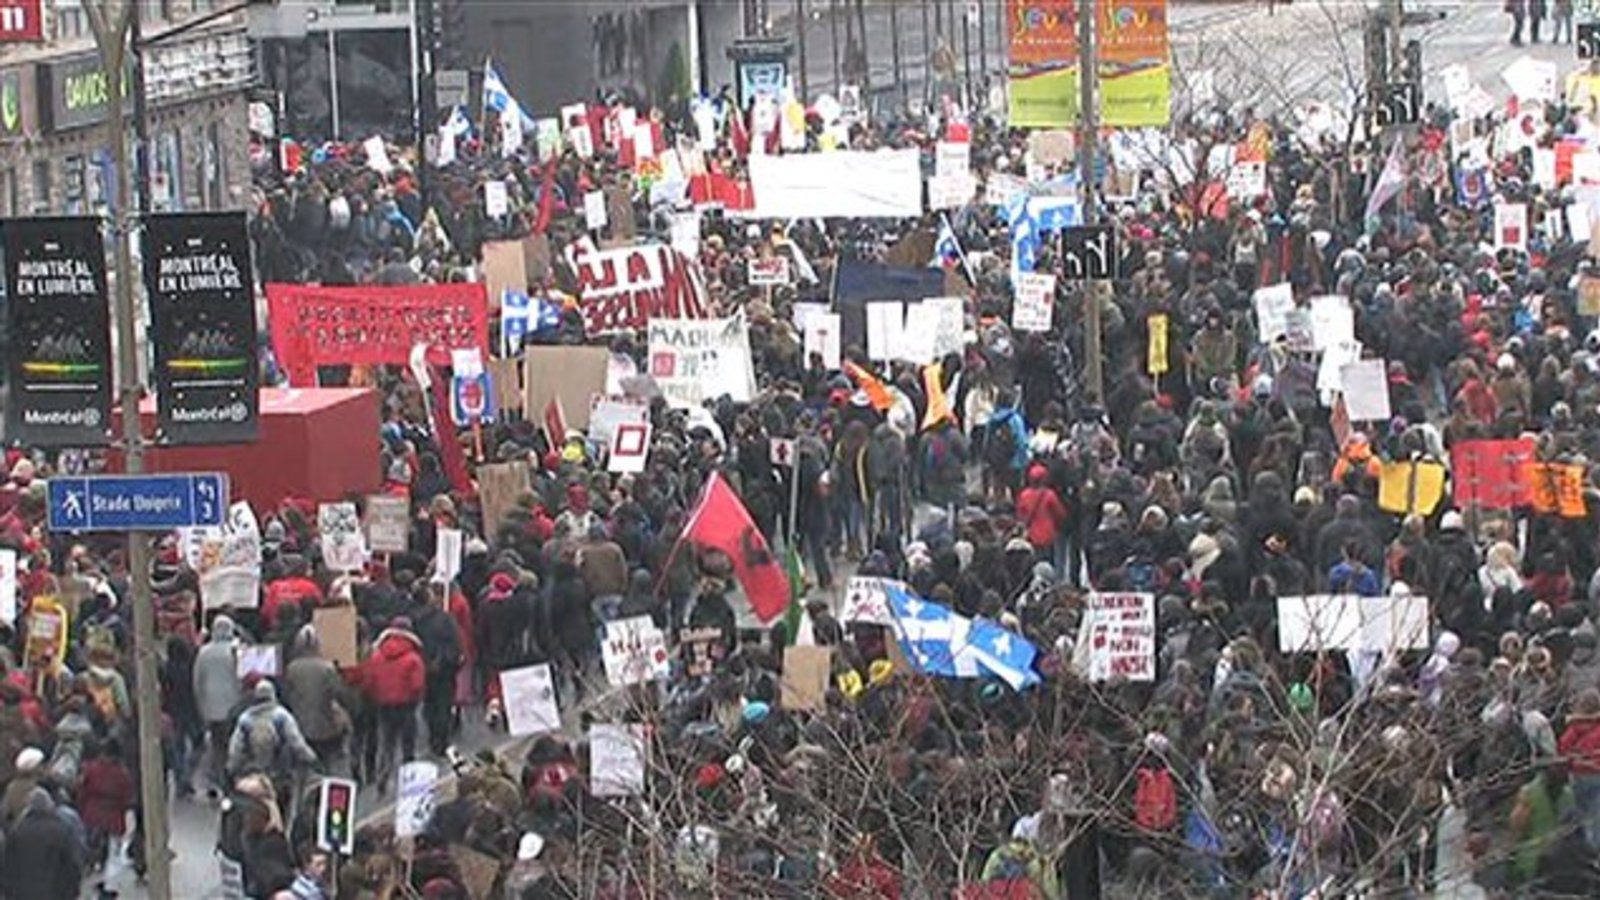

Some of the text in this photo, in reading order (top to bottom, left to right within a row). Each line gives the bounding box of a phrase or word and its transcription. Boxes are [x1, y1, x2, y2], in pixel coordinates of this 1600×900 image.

[160, 253, 238, 274] MONTRÉAL
[17, 279, 34, 295] EN
[159, 276, 177, 292] EN
[93, 494, 130, 512] Stade
